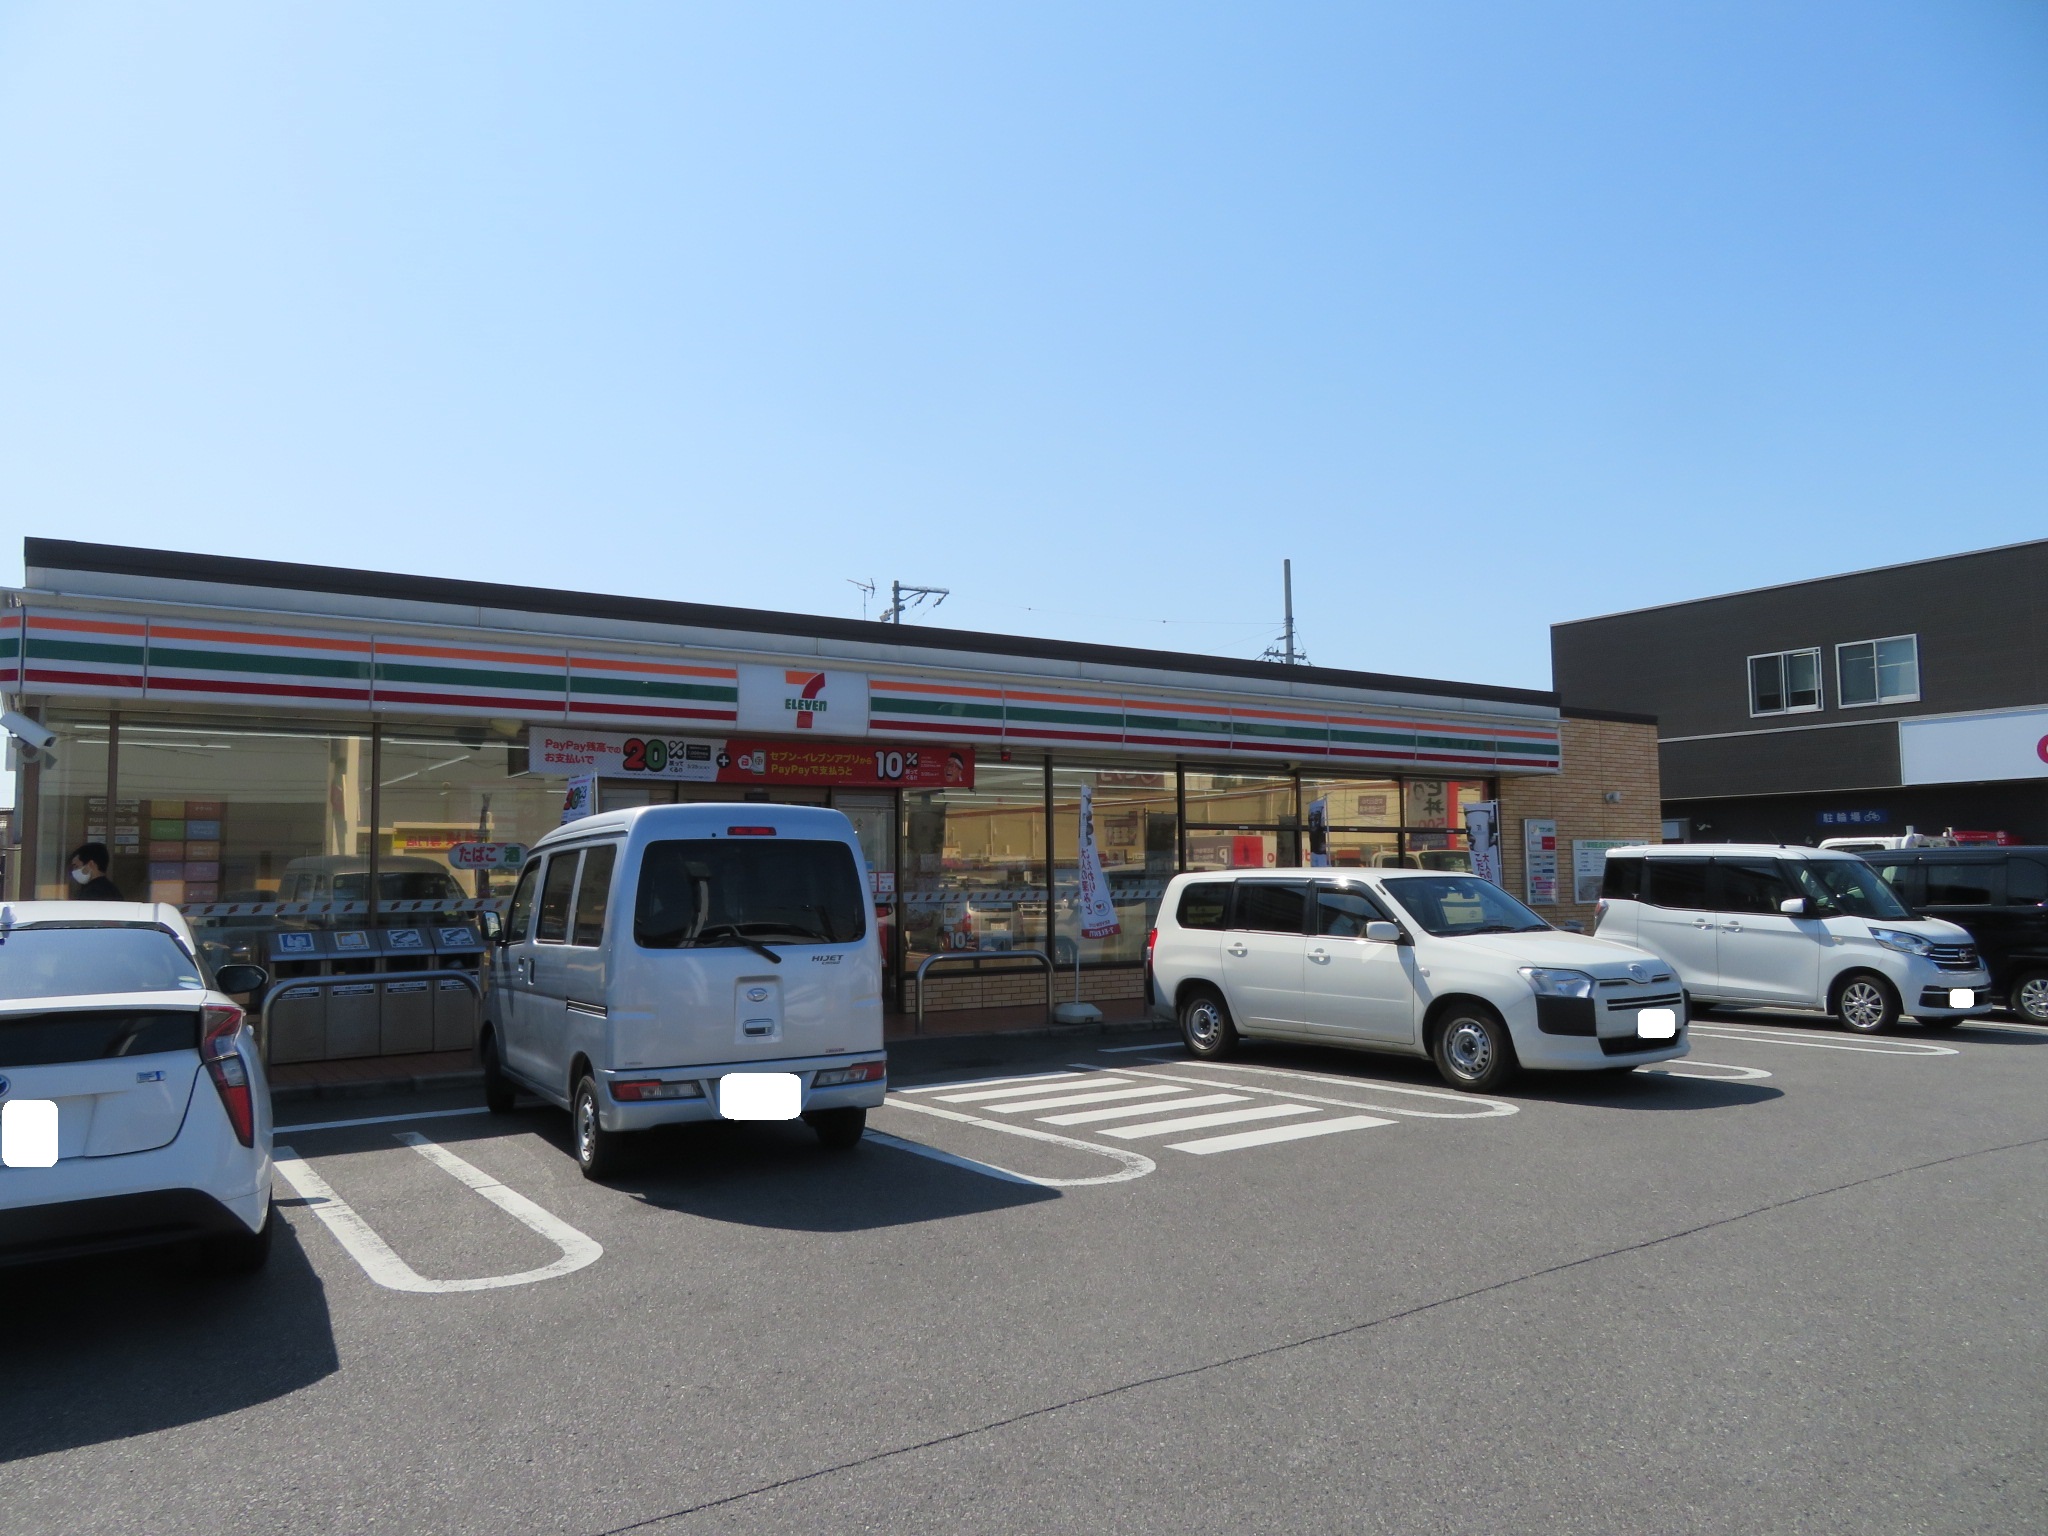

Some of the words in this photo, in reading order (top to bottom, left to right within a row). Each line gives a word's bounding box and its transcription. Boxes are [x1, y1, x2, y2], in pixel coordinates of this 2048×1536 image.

[544, 738, 621, 754] PayPay残高での
[544, 753, 595, 765] お支払いで
[771, 764, 853, 777] PayPayで支払うと
[1822, 811, 1861, 824] 駐輪場
[459, 846, 497, 863] たばこ
[504, 846, 521, 863] 酒
[1481, 852, 1494, 882] 大人の
[811, 954, 844, 962] HIJET
